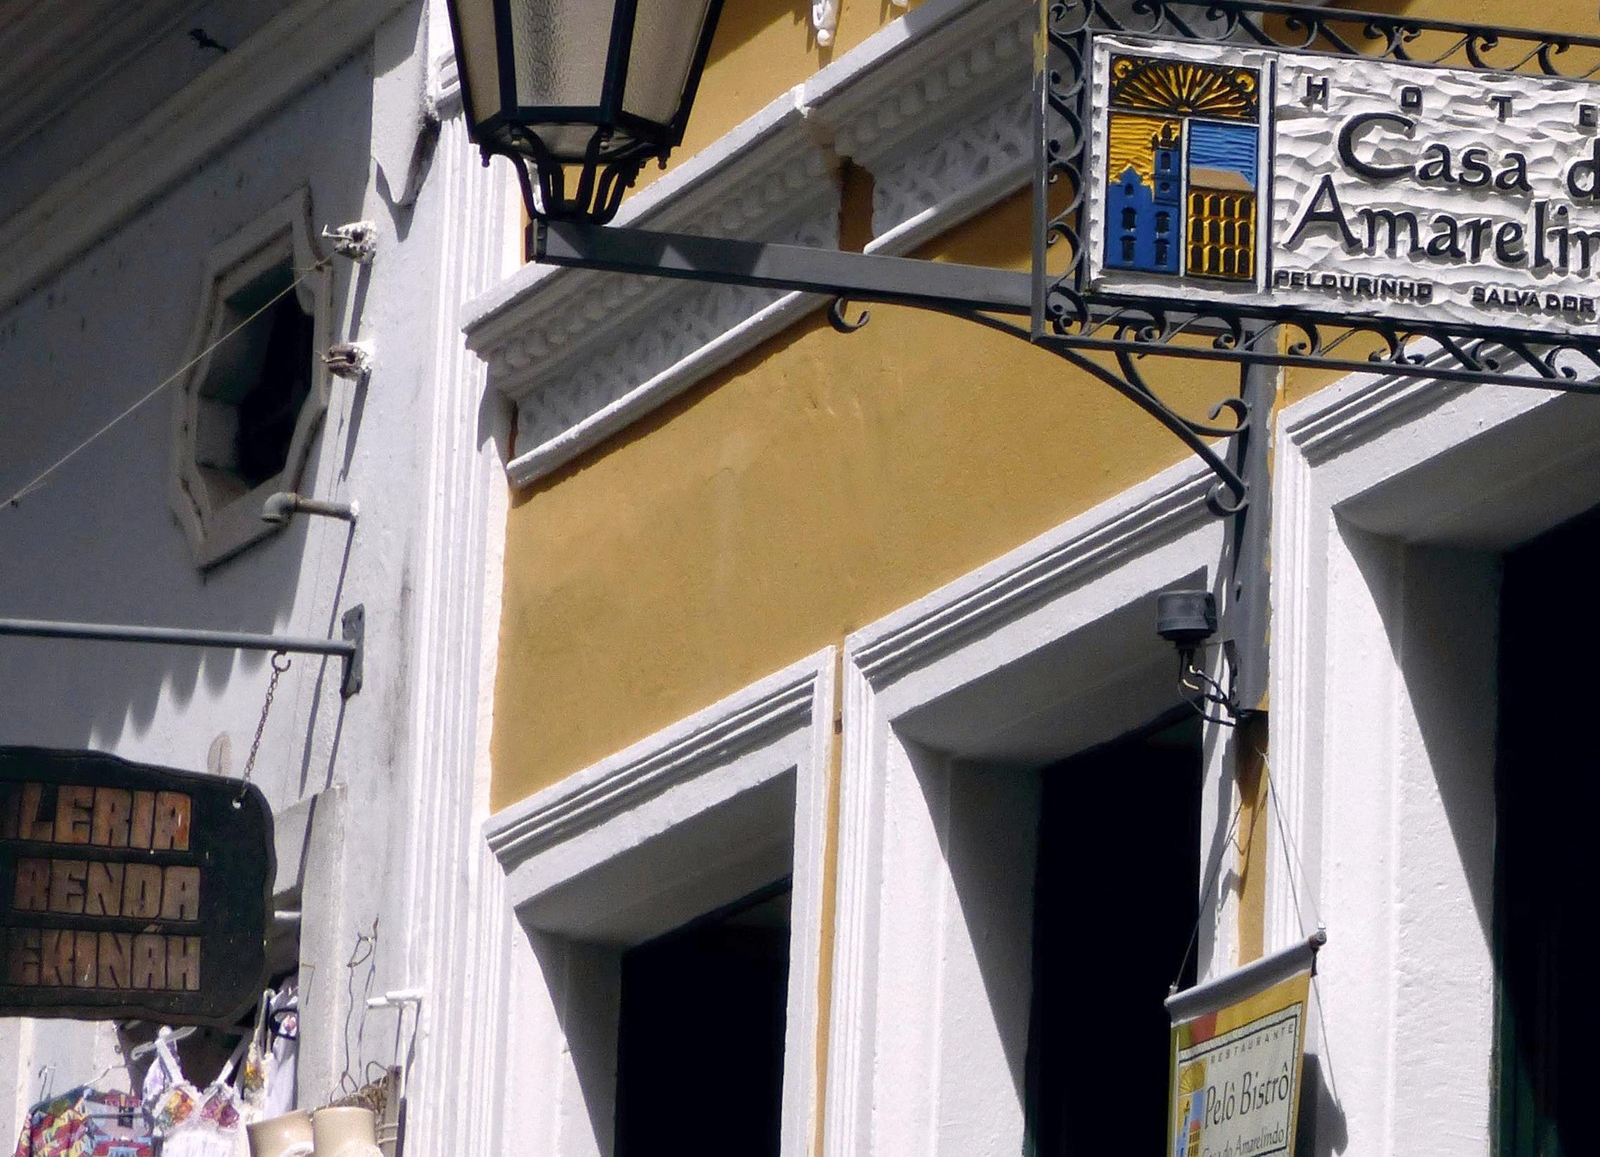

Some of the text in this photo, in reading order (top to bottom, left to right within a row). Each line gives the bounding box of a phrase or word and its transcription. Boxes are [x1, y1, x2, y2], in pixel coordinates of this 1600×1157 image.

[1337, 112, 1531, 194] Casa
[1273, 270, 1433, 301] PELOURINHO
[1473, 287, 1595, 314] SALVADOR
[1211, 1024, 1294, 1064] RESTAURANTE
[1205, 1061, 1289, 1129] Pelô Bistrô
[1235, 1122, 1285, 1156] Amarelindo
